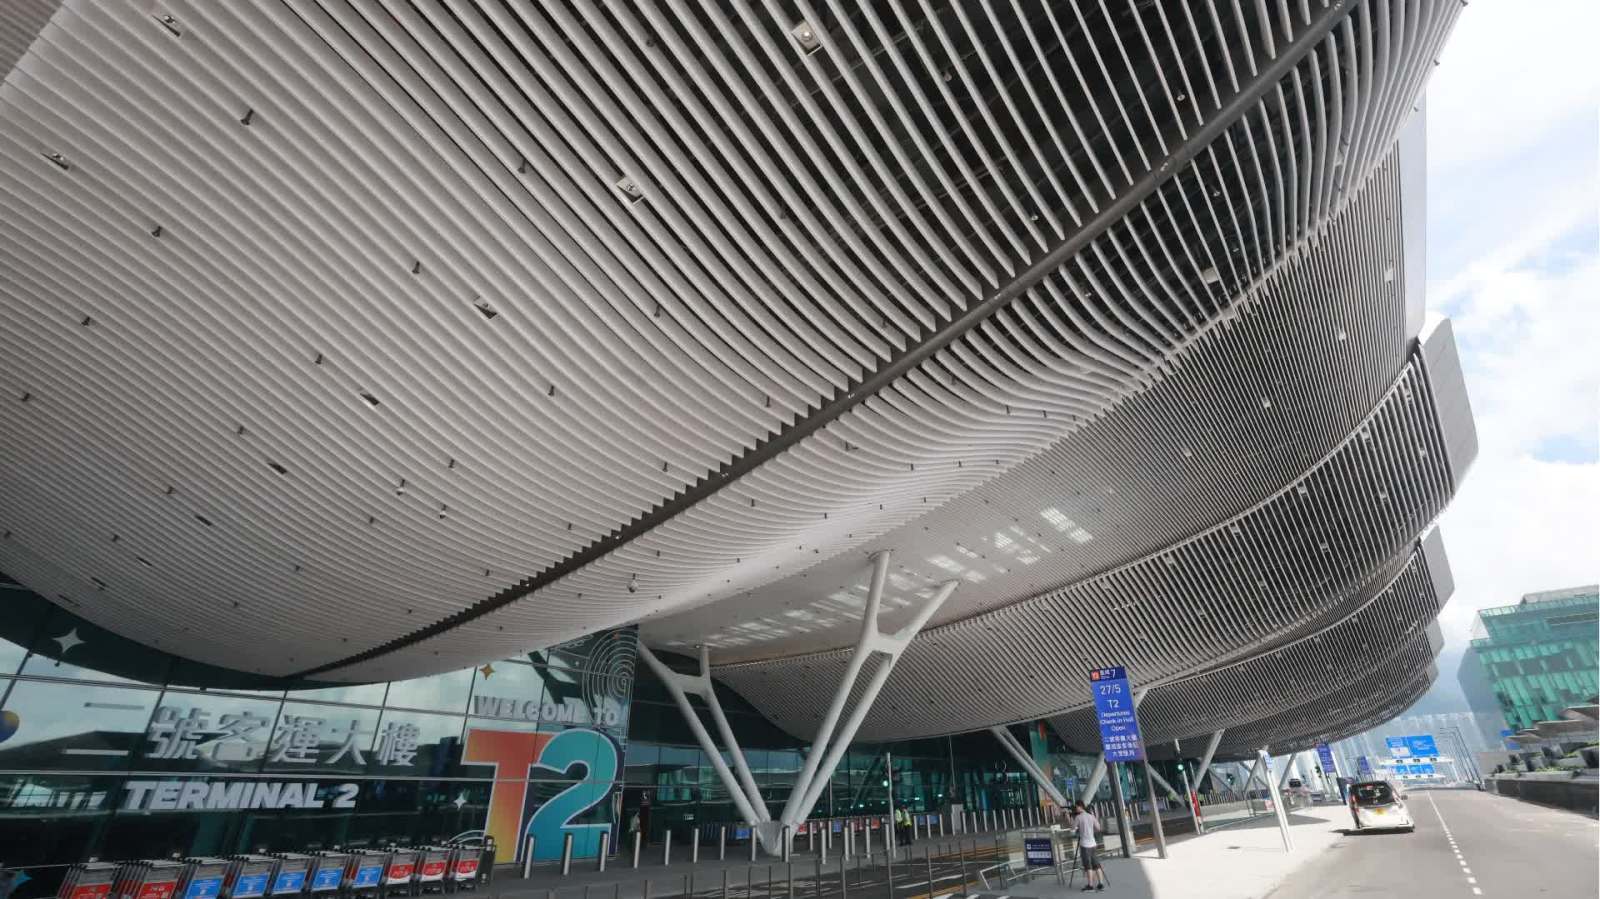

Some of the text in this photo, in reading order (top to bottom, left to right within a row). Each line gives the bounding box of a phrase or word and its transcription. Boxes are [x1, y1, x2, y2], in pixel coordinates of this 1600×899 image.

[1110, 668, 1116, 678] 7
[1100, 684, 1121, 695] 27/5
[1107, 699, 1120, 709] T2
[474, 695, 582, 724] WELCOME
[63, 701, 421, 767] 二號客運大樓
[123, 780, 360, 810] TERMINAL 2
[461, 728, 621, 864] T2
